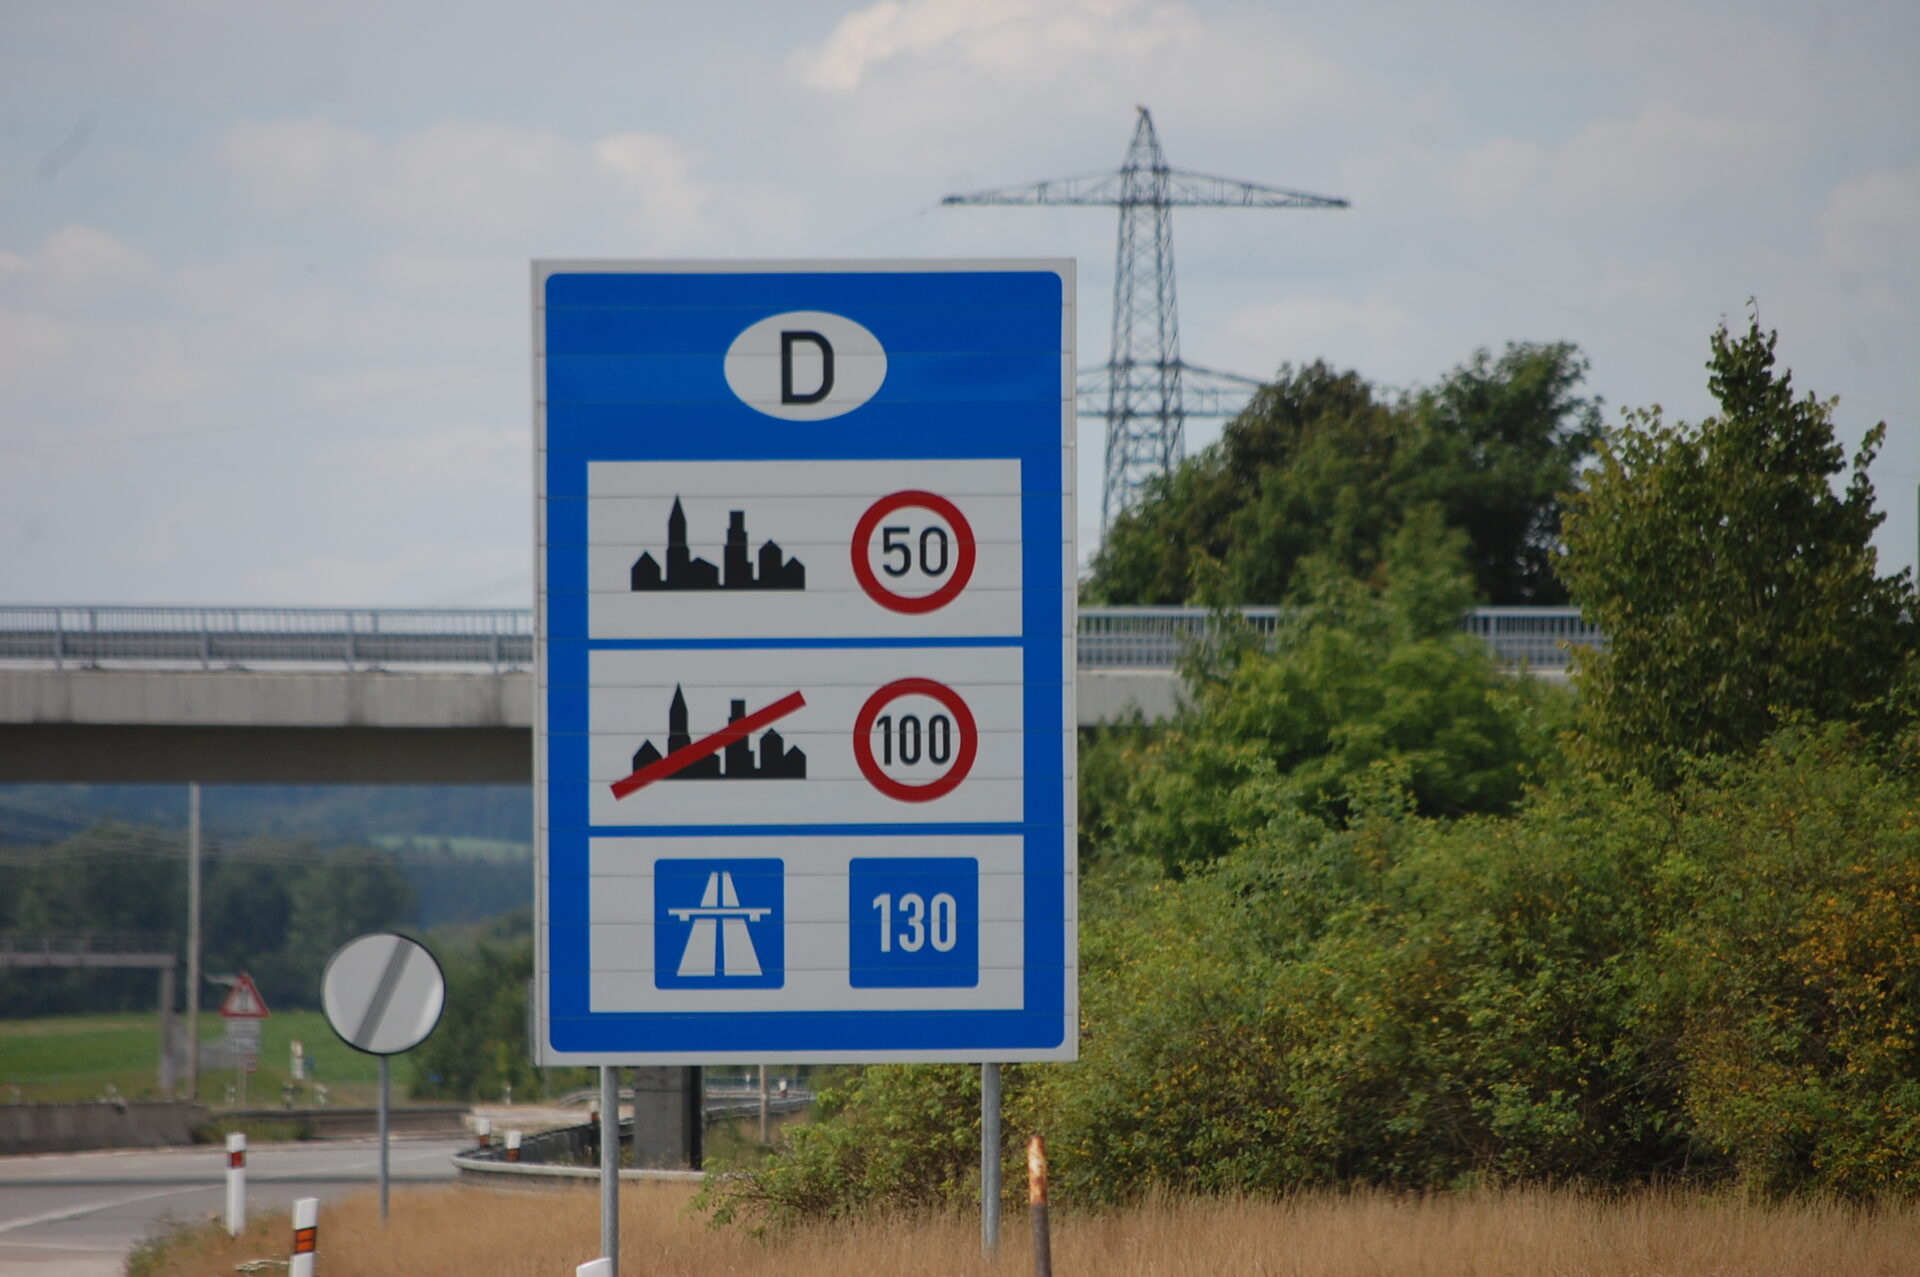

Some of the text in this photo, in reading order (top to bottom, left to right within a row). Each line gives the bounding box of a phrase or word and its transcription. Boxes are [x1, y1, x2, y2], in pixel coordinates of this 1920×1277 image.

[780, 329, 835, 406] D
[882, 526, 949, 578] 50
[876, 714, 952, 767] 100
[873, 892, 957, 953] 130
